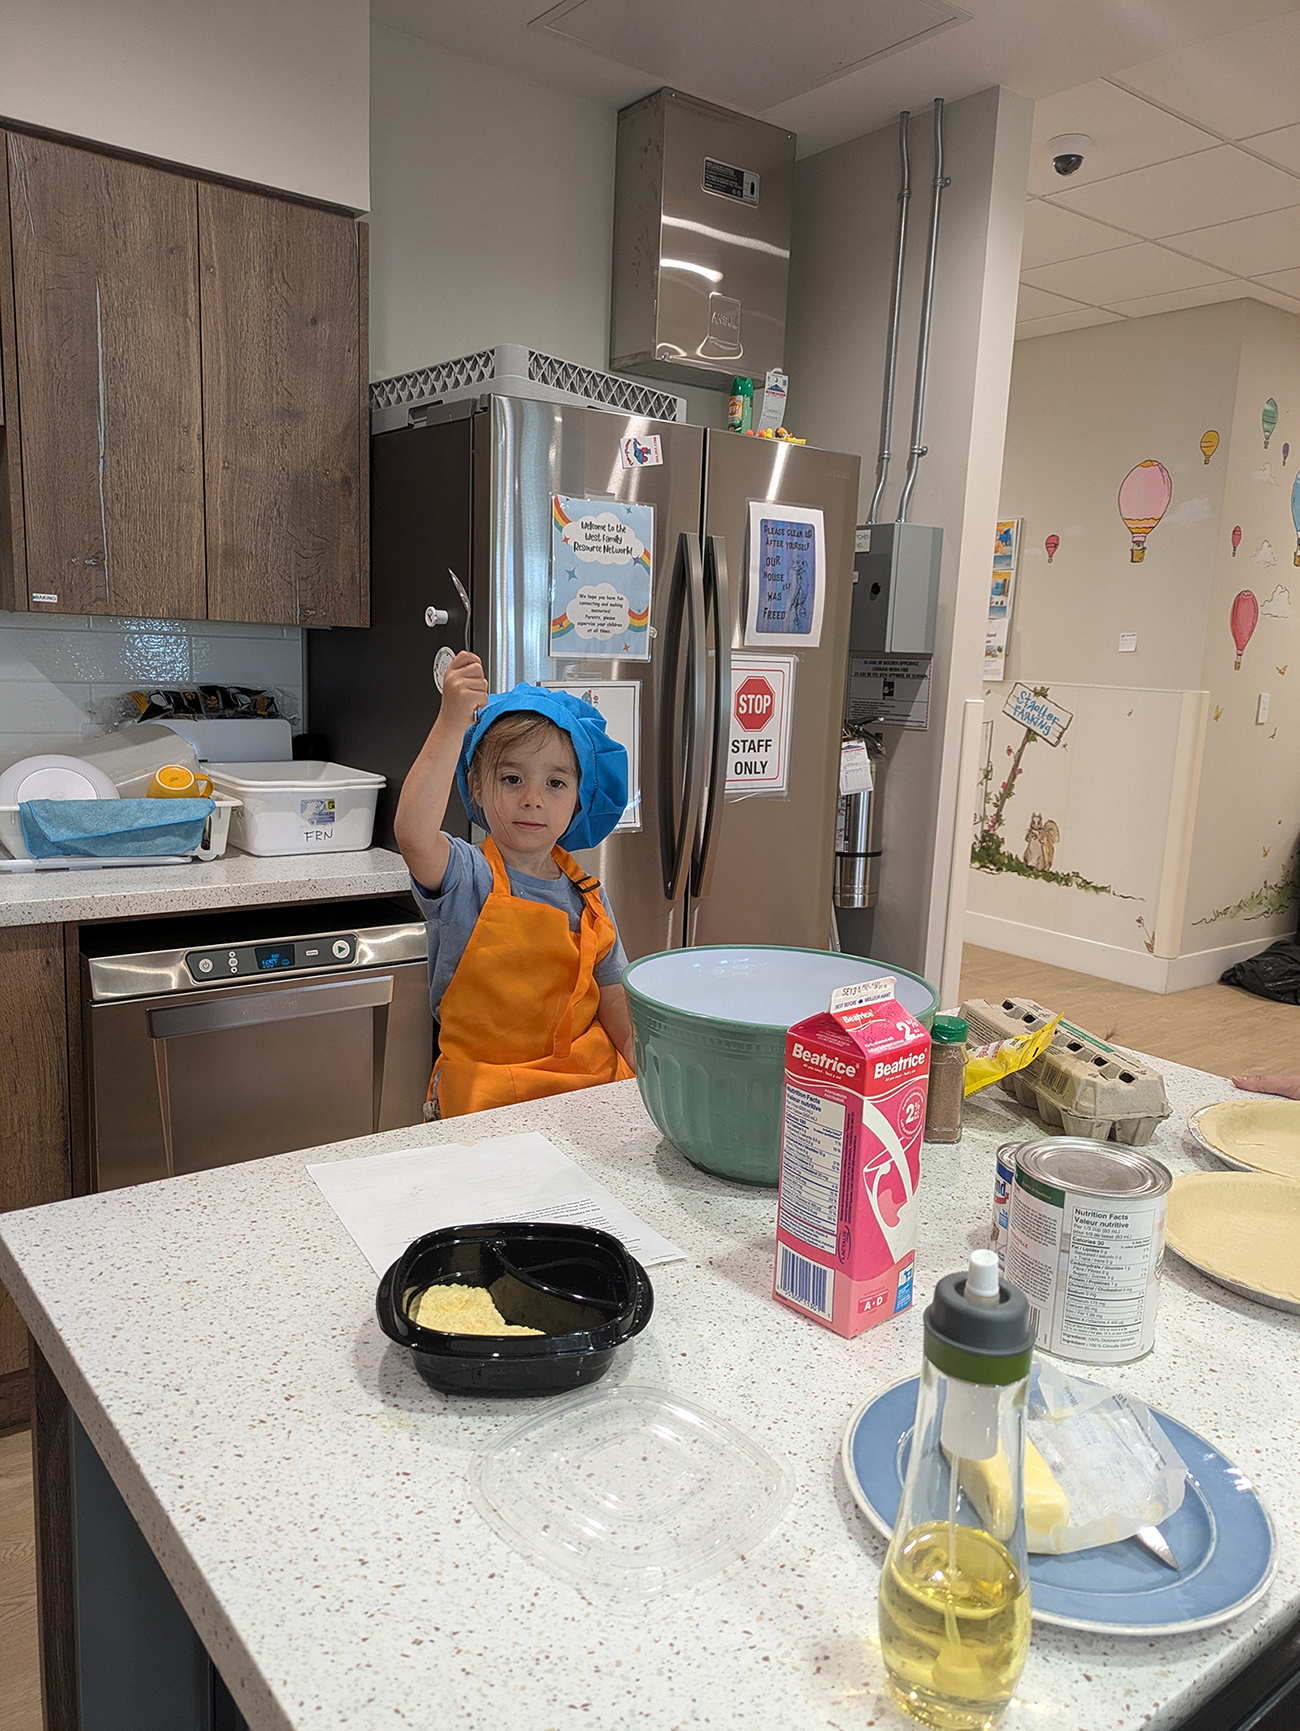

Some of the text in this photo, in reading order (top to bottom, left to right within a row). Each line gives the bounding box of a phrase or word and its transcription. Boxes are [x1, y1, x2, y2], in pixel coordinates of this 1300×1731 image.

[581, 521, 626, 533] Welcome to the
[764, 525, 812, 538] PLEASE CLEAN UP
[585, 532, 601, 542] West
[574, 542, 632, 556] Resource Network!
[765, 538, 810, 551] AFTER YOURSELF
[766, 556, 780, 566] OUR
[763, 571, 784, 582] HOUSE
[768, 592, 782, 601] WAS
[763, 608, 786, 620] FREED
[738, 694, 771, 714] STOP
[731, 740, 772, 753] STAFF
[734, 761, 768, 775] ONLY
[304, 828, 333, 842] FRN
[842, 1009, 874, 1024] Beatrice
[792, 1042, 856, 1077] Beatrice
[874, 1052, 925, 1079] Beatrice
[787, 1086, 820, 1104] Nutrition Facts
[801, 1101, 821, 1112] nutritive
[1075, 1208, 1107, 1220] Nutrition
[1074, 1216, 1098, 1226] Valeur
[1072, 1236, 1096, 1245] Calories
[1070, 1260, 1100, 1269] Carbohydrate
